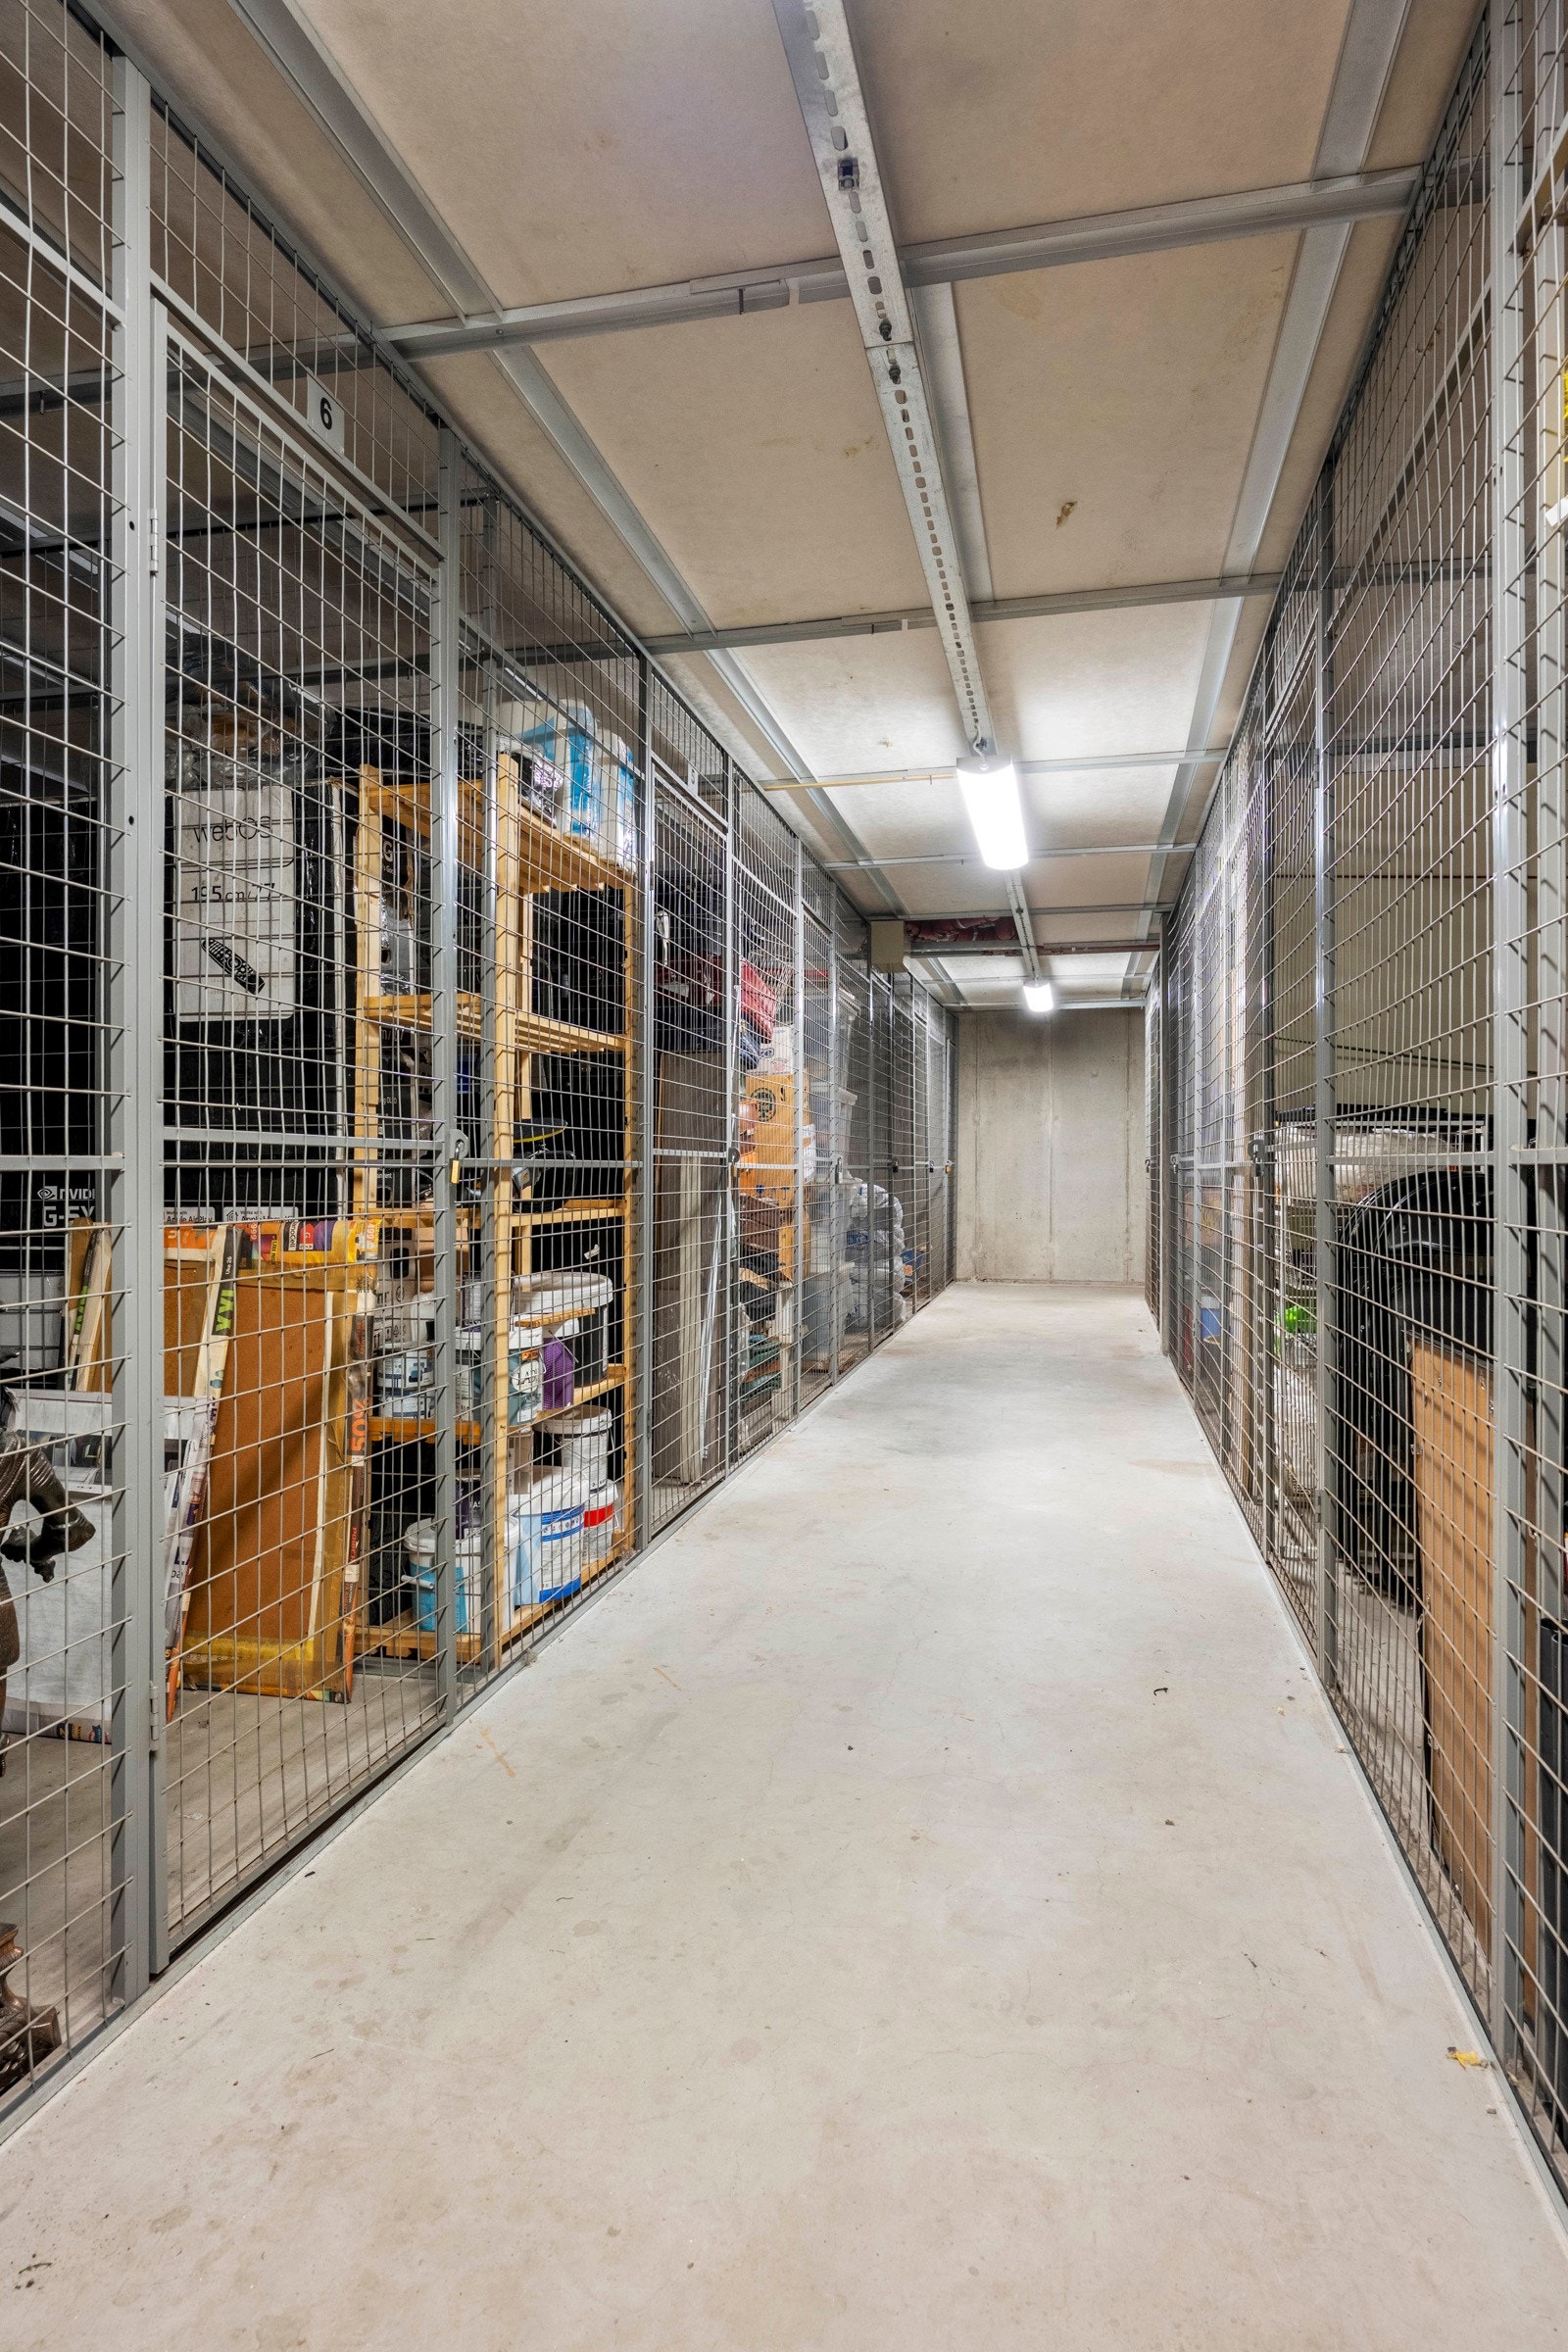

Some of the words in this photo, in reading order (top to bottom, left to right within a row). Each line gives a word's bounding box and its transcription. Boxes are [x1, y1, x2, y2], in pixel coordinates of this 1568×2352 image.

[319, 397, 333, 430] 6
[193, 816, 272, 843] webOS
[60, 1188, 96, 1200] NVIDI
[44, 1205, 95, 1227] G-SY
